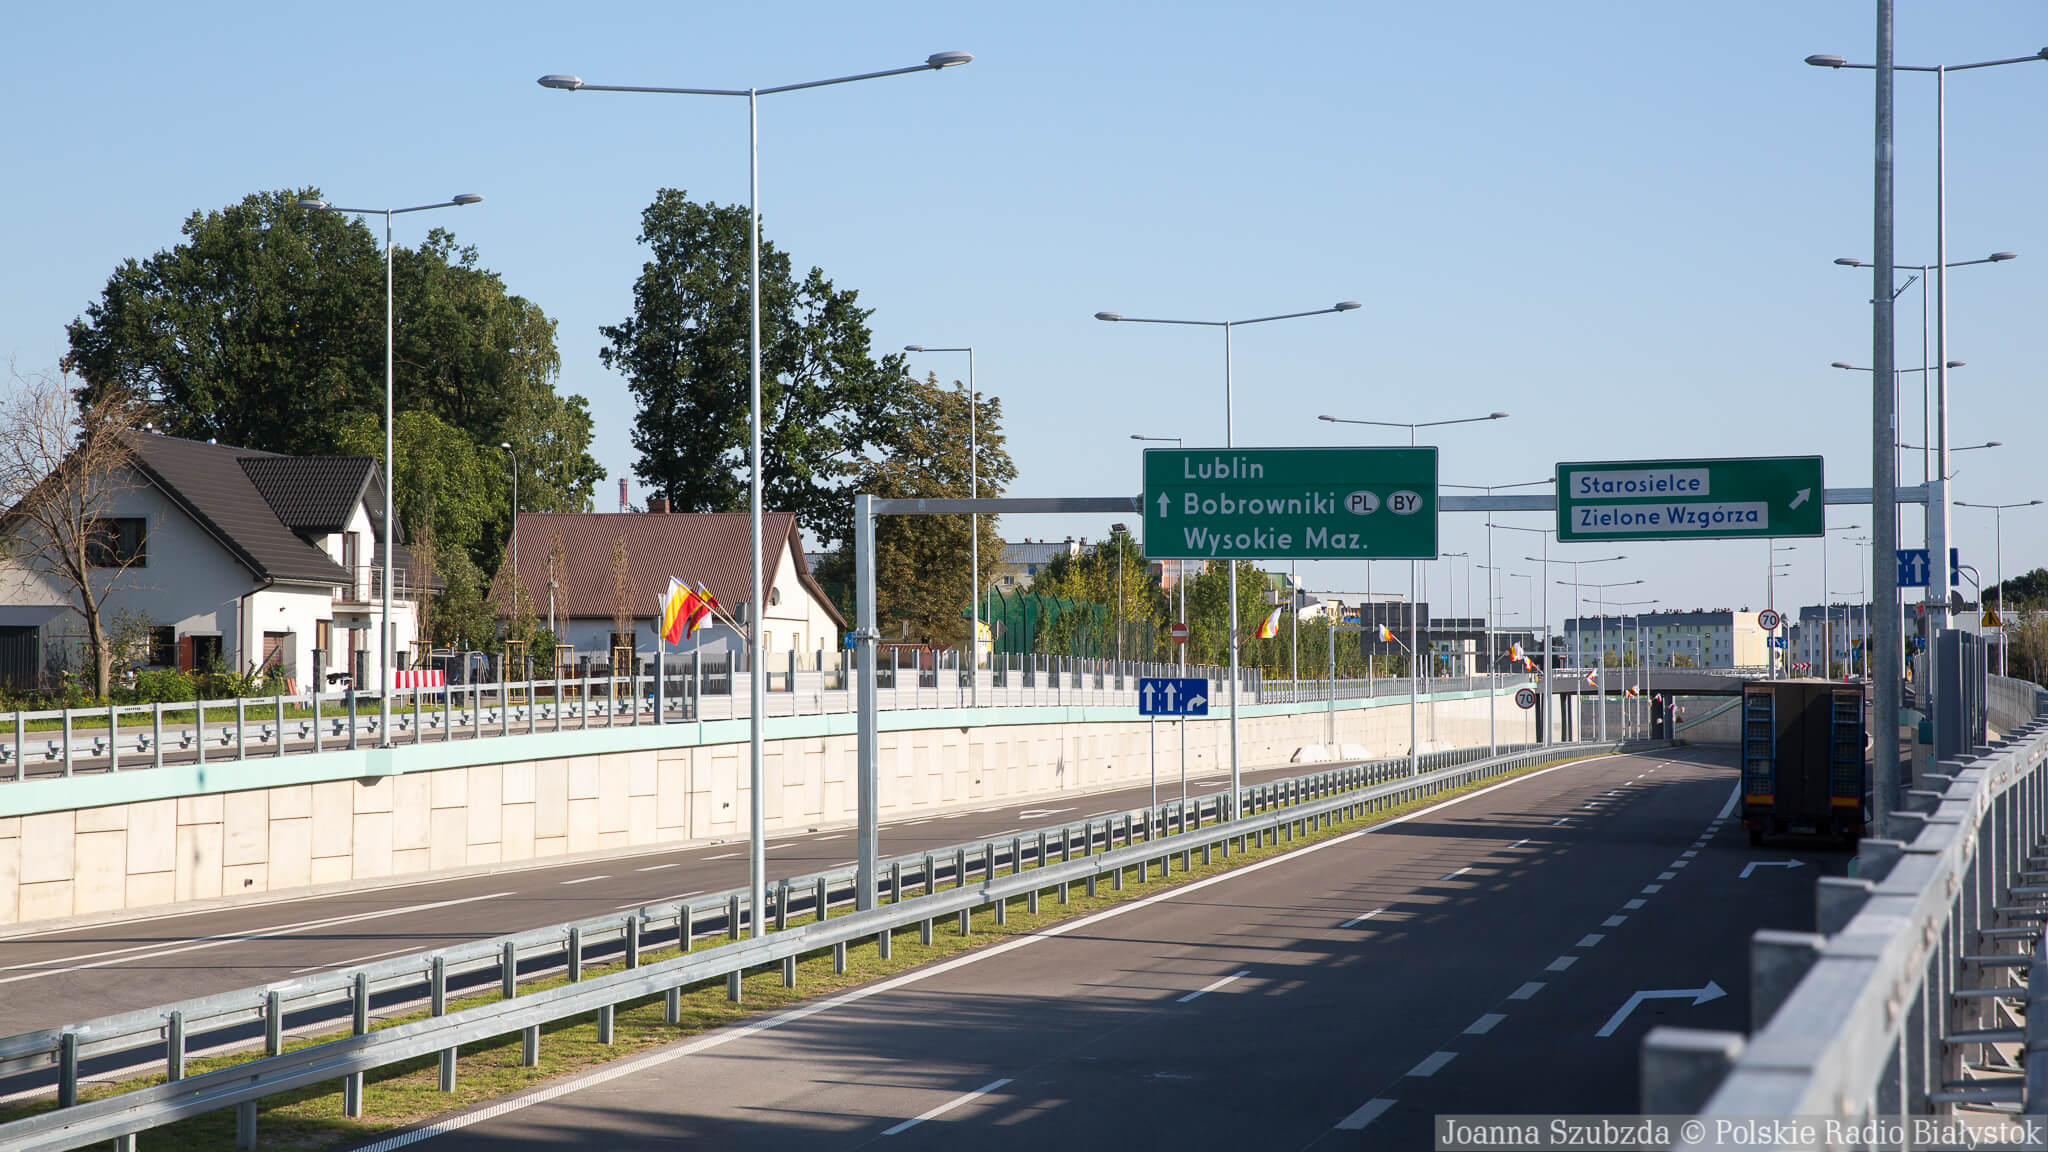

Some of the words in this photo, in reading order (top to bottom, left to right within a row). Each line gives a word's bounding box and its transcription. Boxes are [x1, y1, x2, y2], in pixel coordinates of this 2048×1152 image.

[1184, 456, 1264, 479] Lublin
[1580, 473, 1701, 494] Starosielce
[1184, 491, 1335, 515] Bobrowniki
[1351, 495, 1373, 511] PL
[1394, 495, 1417, 511] BY
[1580, 508, 1661, 527] Zielone
[1666, 505, 1759, 529] Wzgórza
[1183, 527, 1293, 556] Wysokie
[1305, 526, 1368, 550] Maz.
[1762, 614, 1777, 626] 70
[1519, 693, 1533, 705] 70
